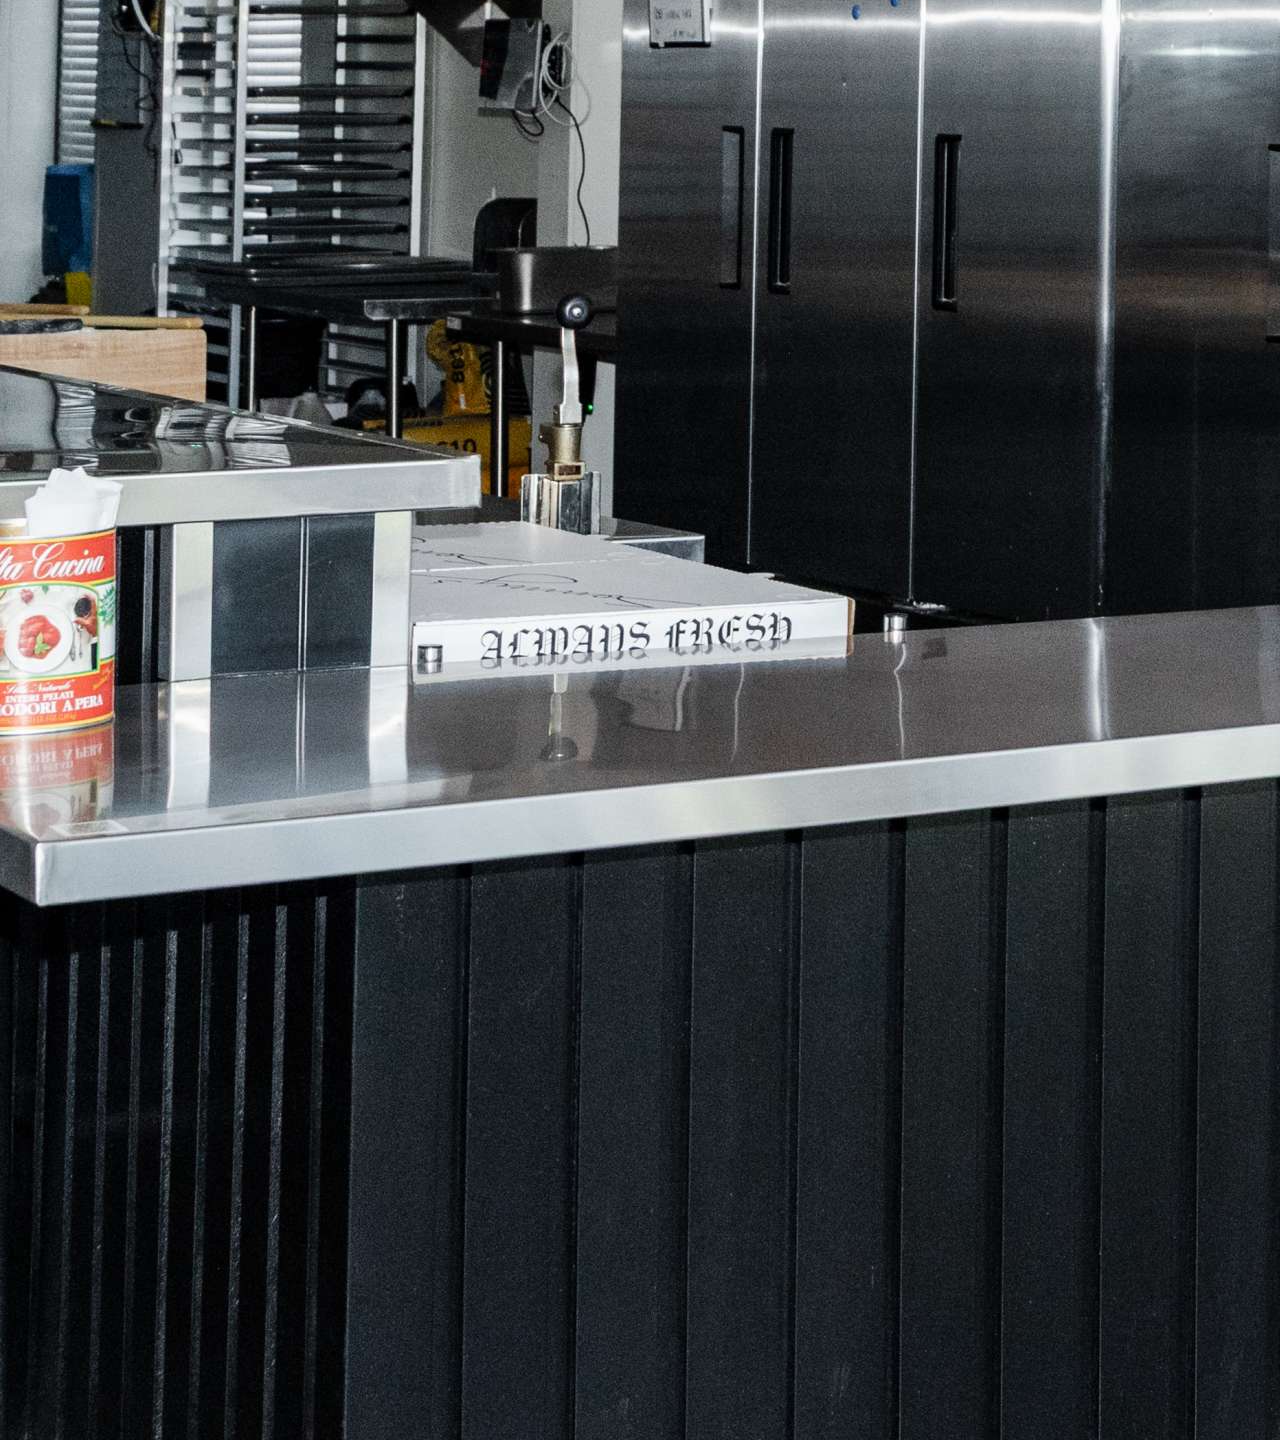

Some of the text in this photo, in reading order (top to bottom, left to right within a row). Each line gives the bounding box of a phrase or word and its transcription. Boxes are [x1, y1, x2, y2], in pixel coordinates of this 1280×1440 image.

[32, 542, 104, 580] Cucina
[665, 612, 793, 649] FRESH
[63, 700, 74, 712] A
[75, 694, 104, 710] PERA
